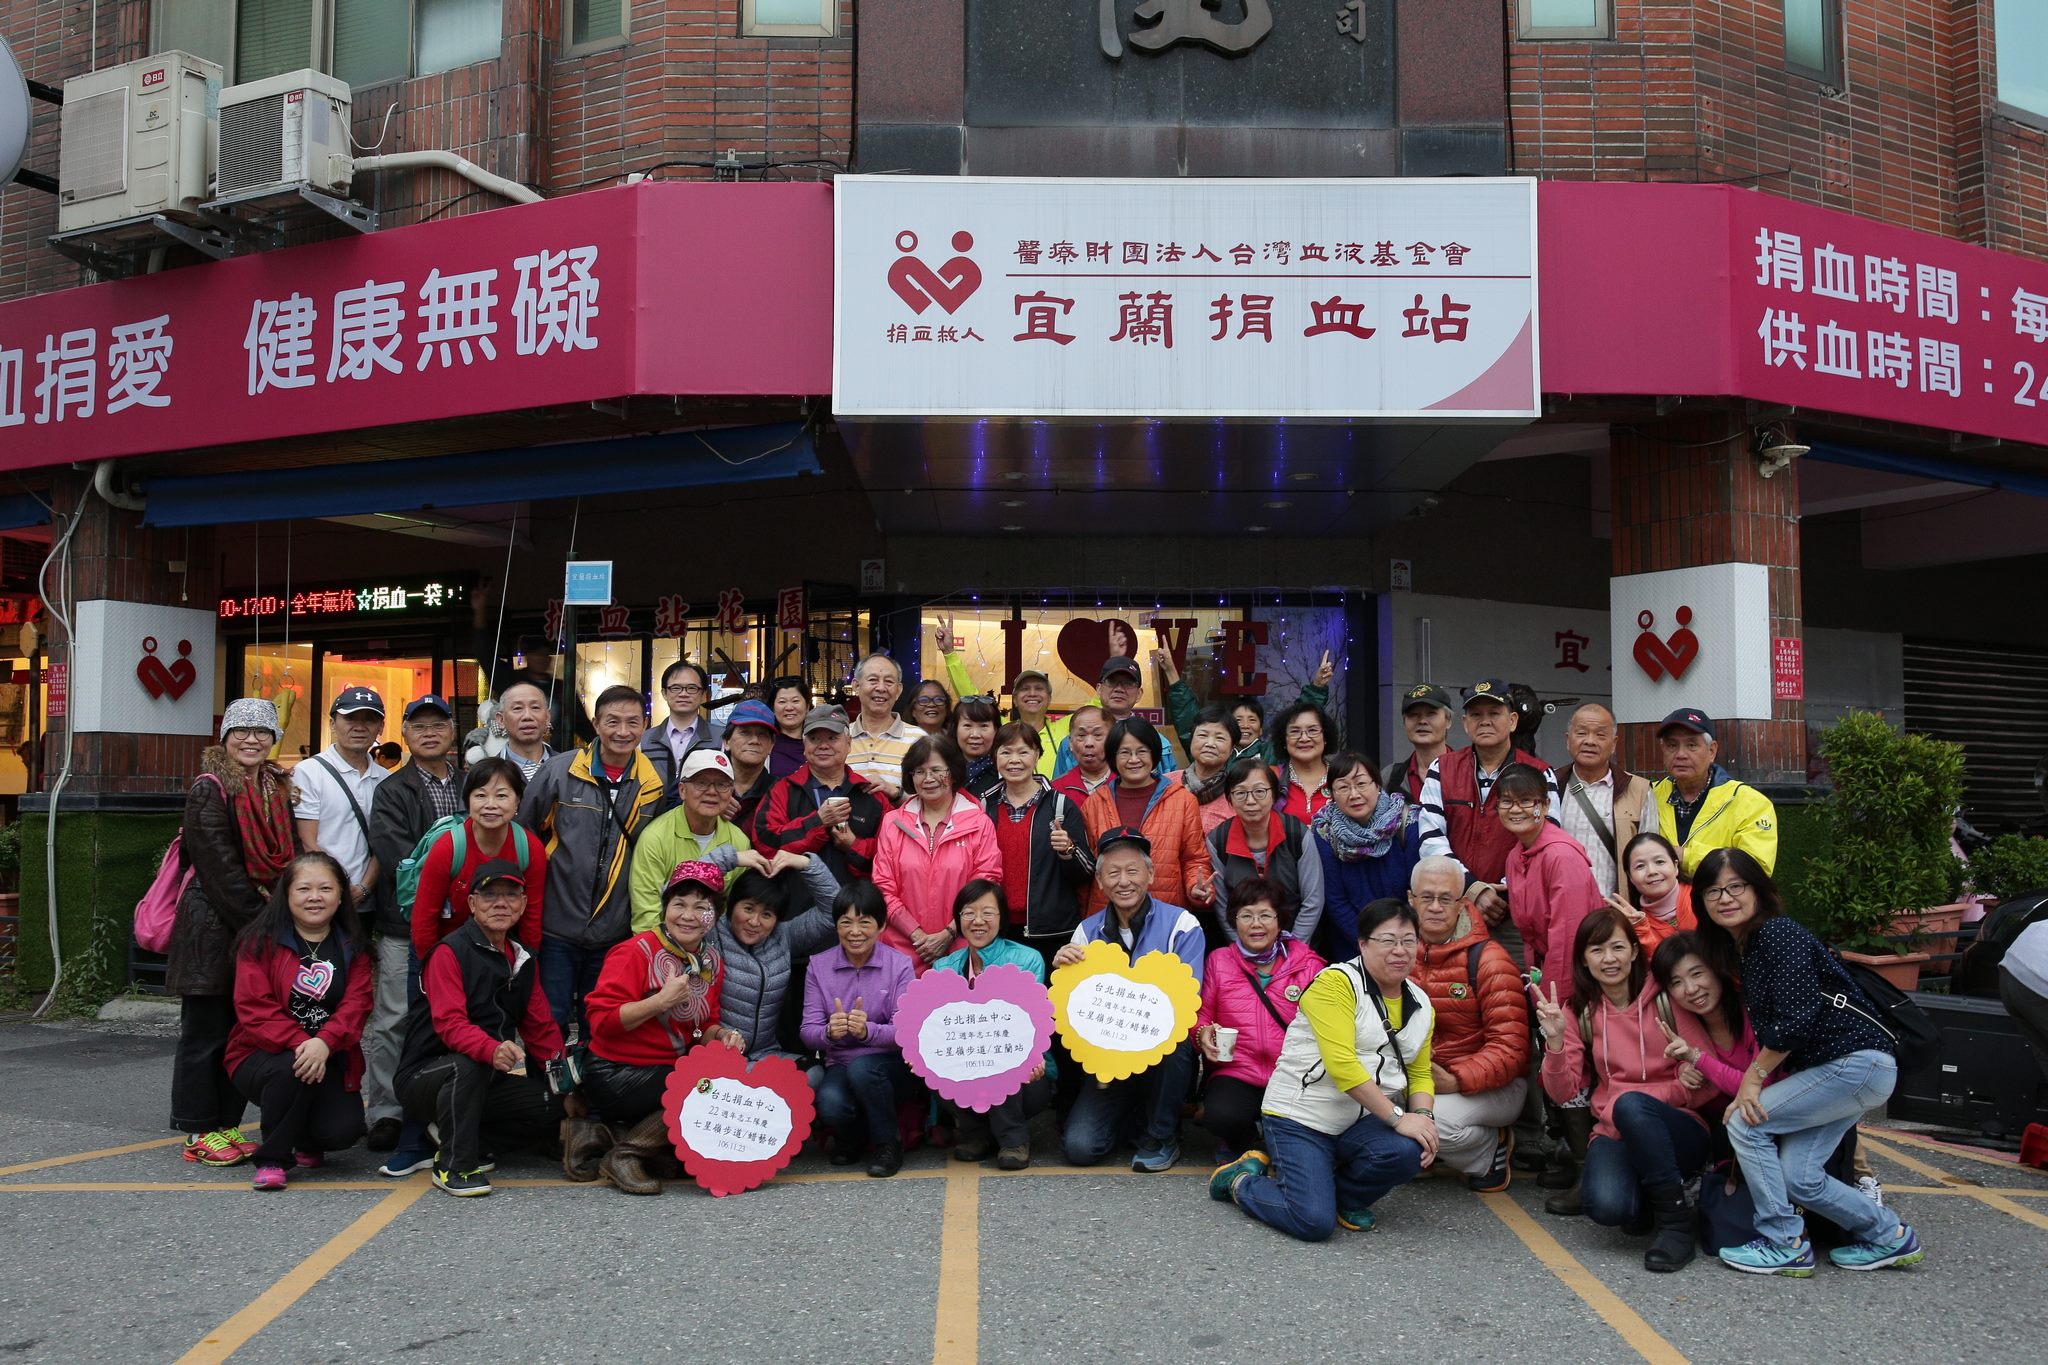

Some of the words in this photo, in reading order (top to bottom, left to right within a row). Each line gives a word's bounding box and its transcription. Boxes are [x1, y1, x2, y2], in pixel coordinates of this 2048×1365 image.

[1013, 239, 1473, 267] 醫療財團法人台灣血液基金會
[243, 245, 601, 396] 健康無礙
[1013, 290, 1471, 349] 宜蘭捐血站
[886, 323, 985, 345] 捐血救人
[1094, 981, 1160, 1005] 台北捐血中心
[942, 1012, 1013, 1026] 台北捐血中心
[944, 1031, 957, 1041] 22
[707, 1105, 719, 1117] 22
[710, 1088, 776, 1113] 台北捐血中心
